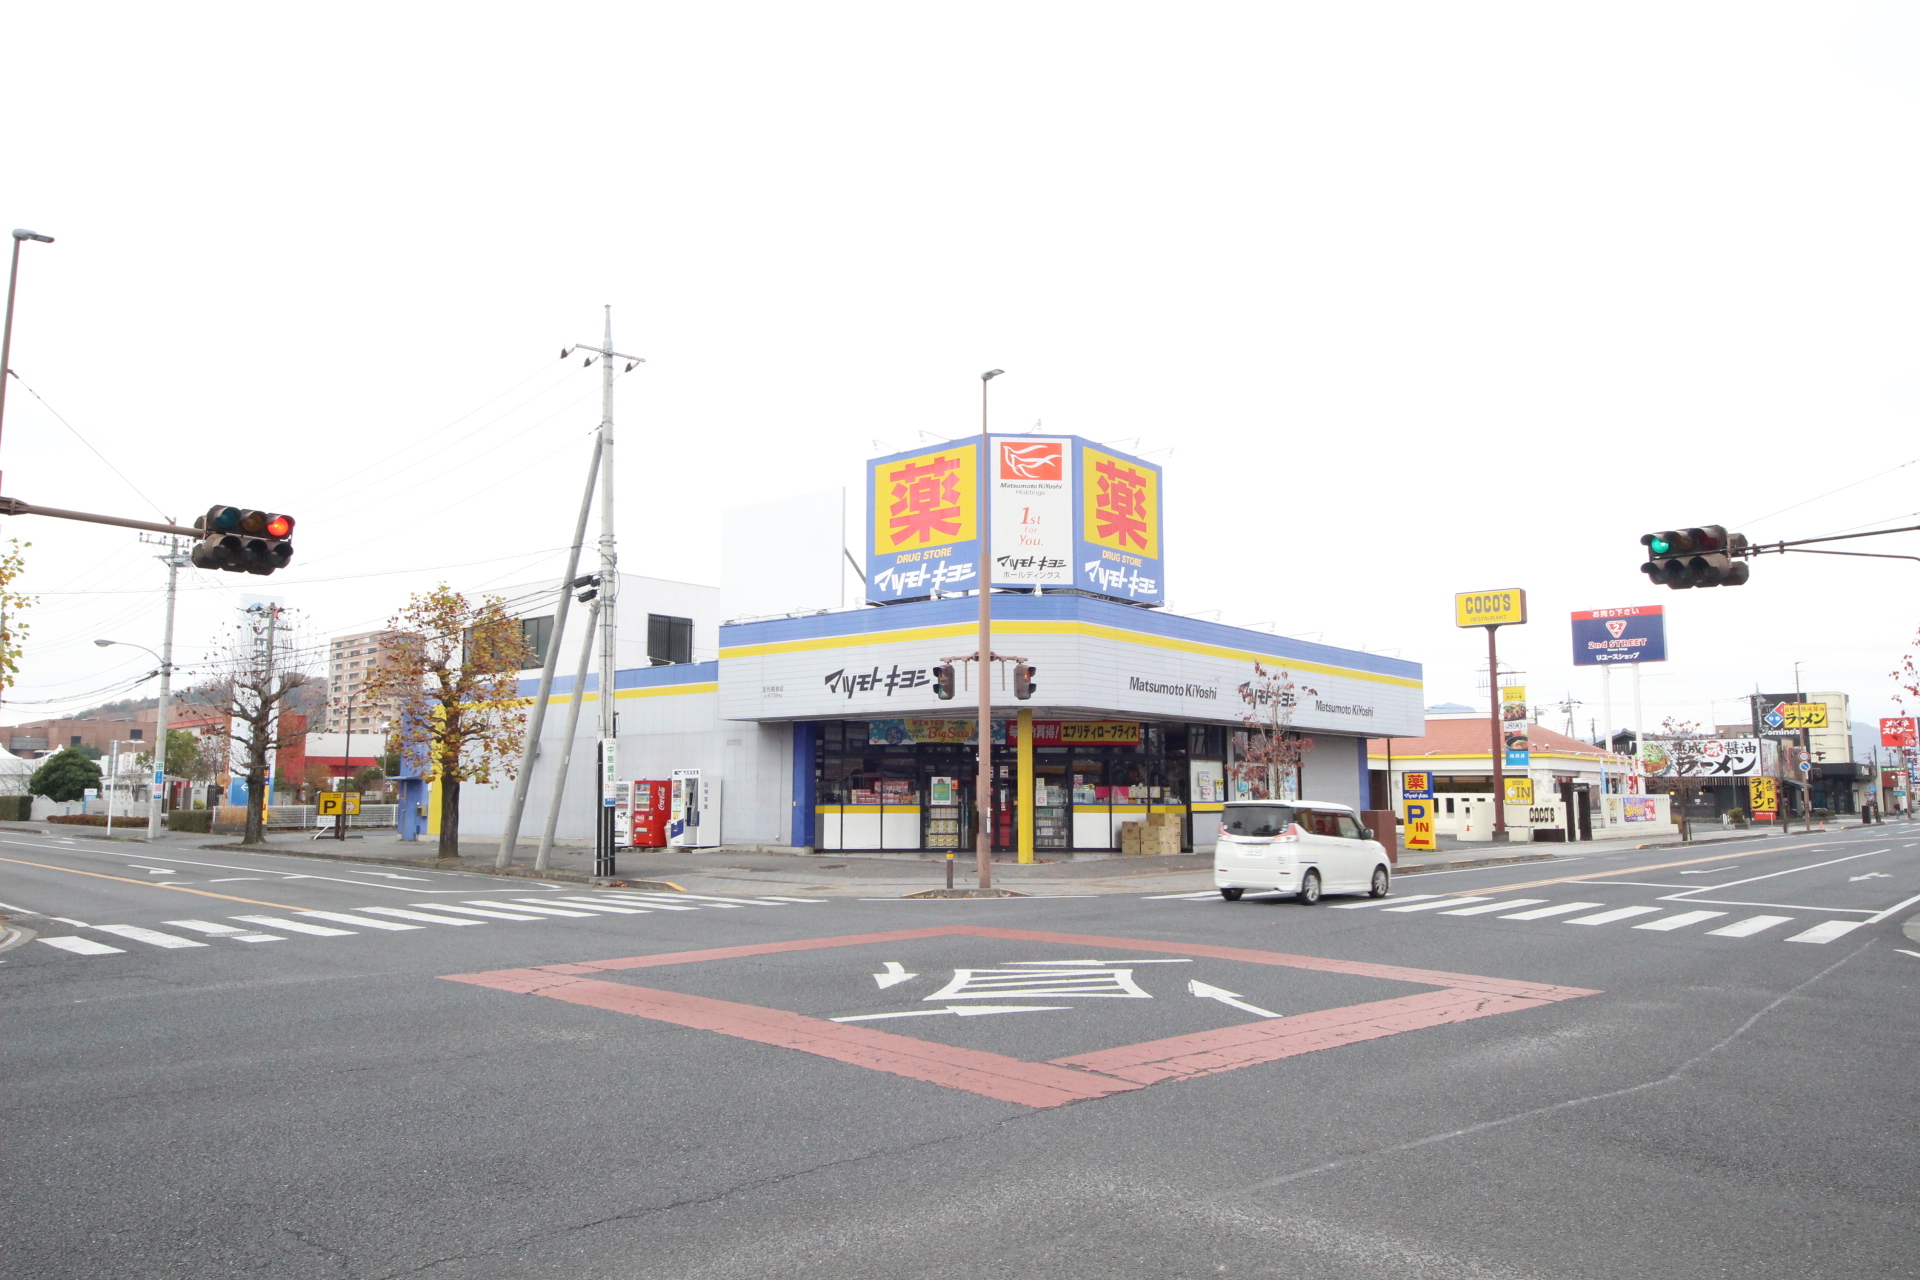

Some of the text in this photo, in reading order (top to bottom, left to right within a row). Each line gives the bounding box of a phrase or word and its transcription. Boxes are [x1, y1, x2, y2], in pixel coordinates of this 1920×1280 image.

[889, 456, 962, 546] 薬
[1096, 460, 1148, 550] 薬
[1020, 507, 1042, 525] 1st
[1024, 526, 1038, 534] for
[896, 547, 953, 564] DRUG STORE
[997, 555, 1067, 571] マツモトキヨシ
[1102, 550, 1143, 567] DRUG STORE
[874, 561, 976, 596] マツモトキヨシ
[1003, 571, 1061, 579] ホールディングス
[1085, 560, 1158, 597] マツモトキヨシ
[1466, 593, 1511, 614] COCO'S
[1592, 608, 1640, 618] お売り下さい
[1588, 638, 1647, 649] 2nd STREET
[1596, 652, 1640, 661] リユースショップ
[824, 664, 931, 700] マツモトキヨシ
[1129, 676, 1217, 699] Matsumoto KiYoshi
[1315, 700, 1374, 717] Matsumoto KiYoshi
[1785, 712, 1826, 726] ラーメン
[927, 727, 947, 742] Big
[1760, 727, 1801, 736] omino's
[1675, 754, 1757, 775] ラーメン
[1407, 774, 1425, 789] 薬
[1516, 787, 1531, 798] IN
[1751, 778, 1765, 809] ラーメン
[323, 800, 337, 814] P
[1767, 797, 1775, 806] P
[1407, 804, 1425, 824] P
[1529, 807, 1555, 823] COCO'S
[1415, 822, 1430, 833] IN
